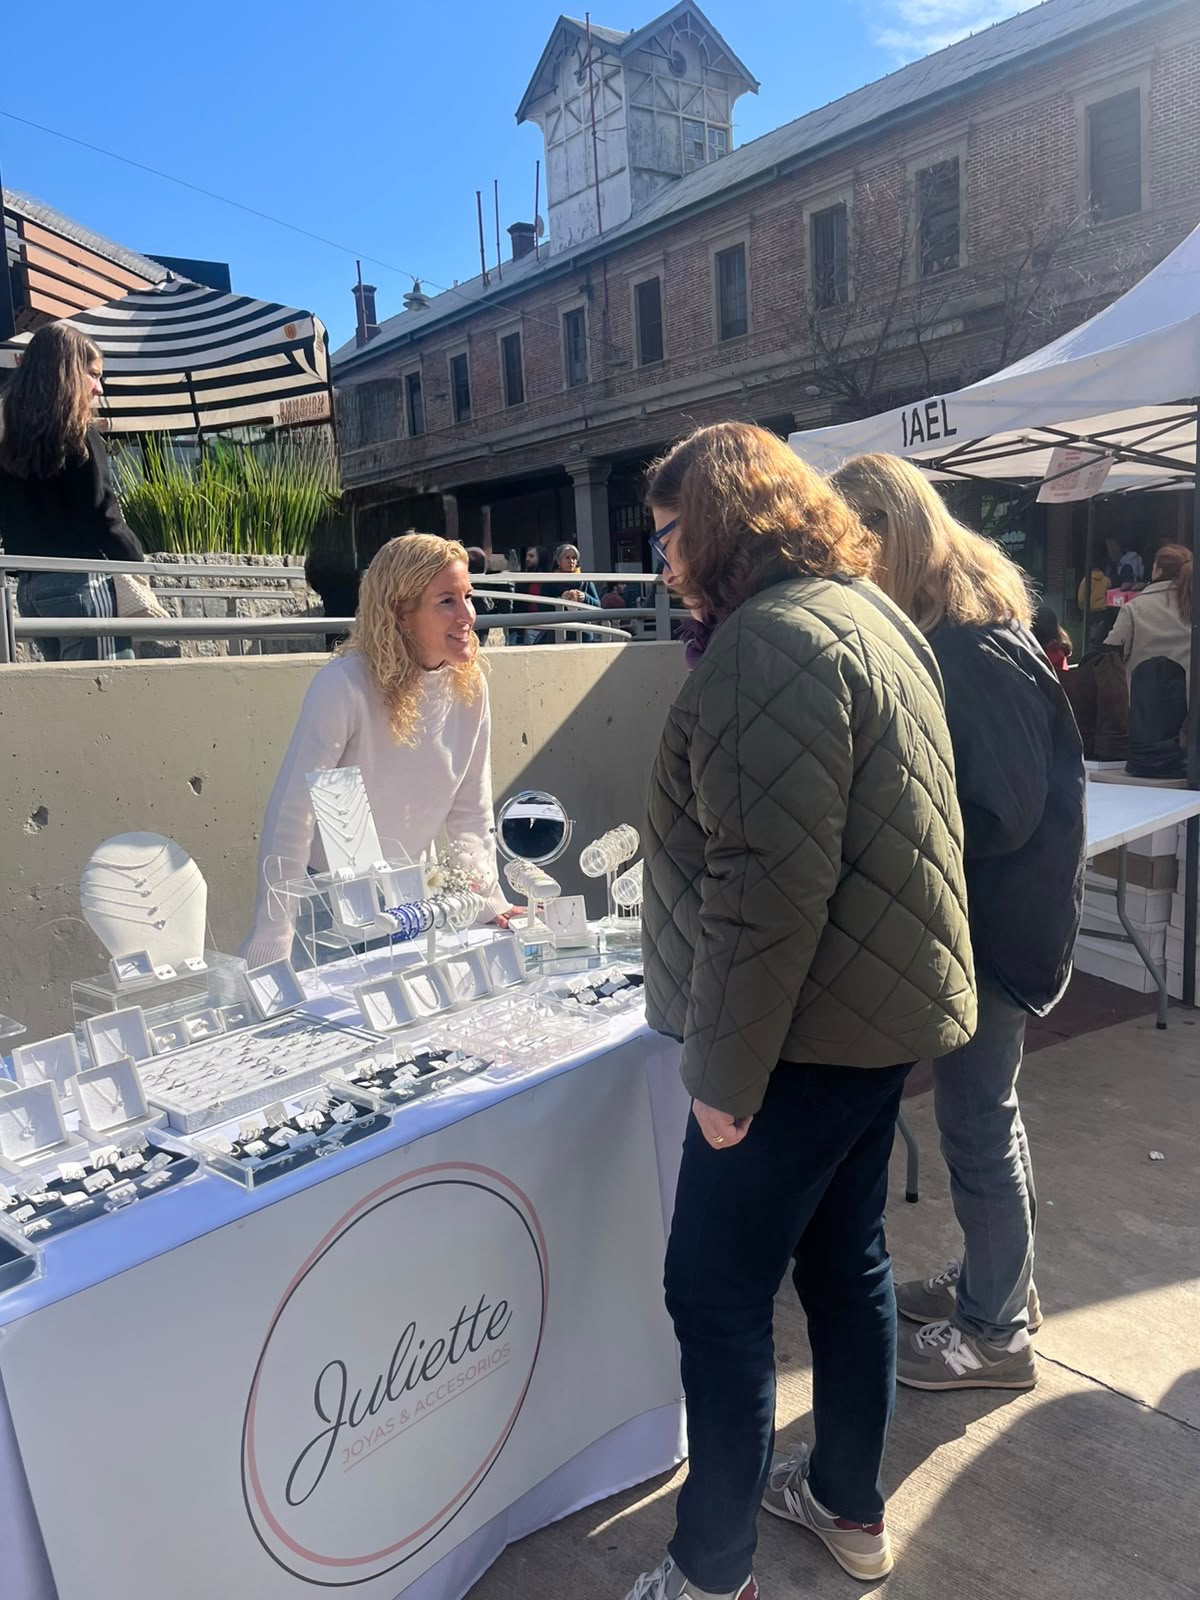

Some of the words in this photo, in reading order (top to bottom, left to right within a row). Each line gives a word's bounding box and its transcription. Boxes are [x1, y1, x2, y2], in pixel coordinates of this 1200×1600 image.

[902, 399, 957, 447] IAEL
[285, 1294, 513, 1506] Juliette
[343, 1417, 395, 1465] JOYAS
[399, 1409, 410, 1425] &
[414, 1343, 511, 1416] ACCESORIOS
